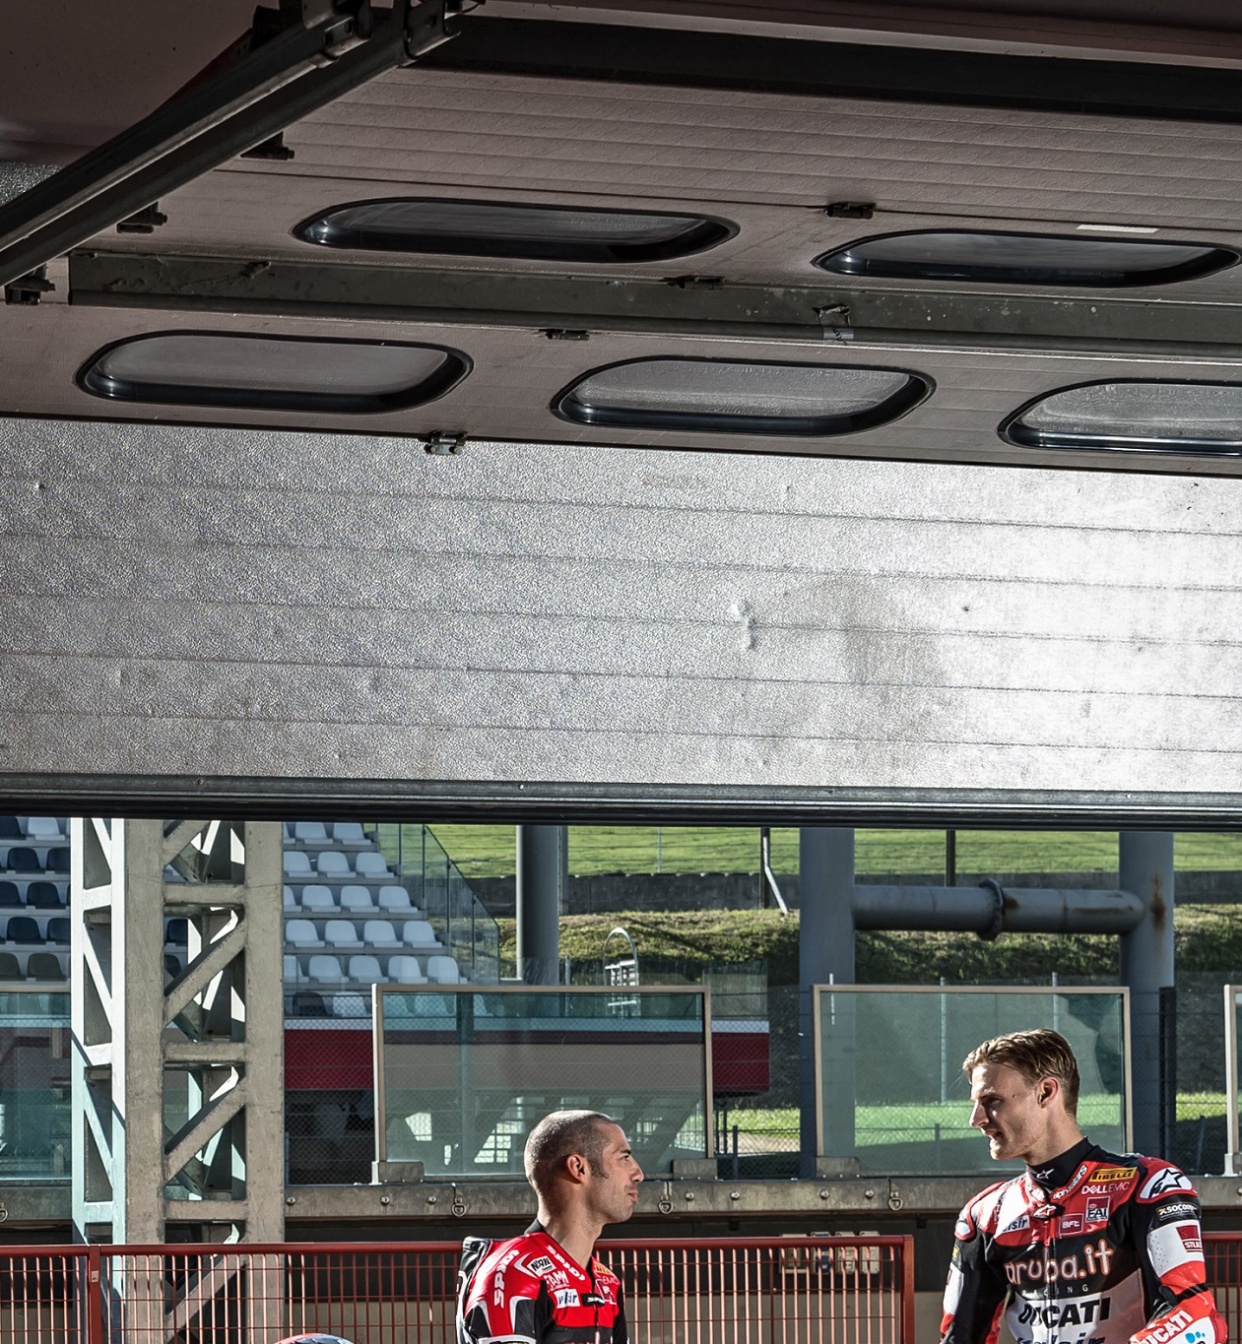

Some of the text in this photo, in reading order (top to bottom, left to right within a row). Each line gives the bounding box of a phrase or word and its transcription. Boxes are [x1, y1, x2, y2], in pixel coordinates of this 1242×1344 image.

[1092, 1171, 1132, 1181] PIRELLI
[1003, 1240, 1114, 1286] aruba.it
[1017, 1296, 1112, 1330] DUCATI
